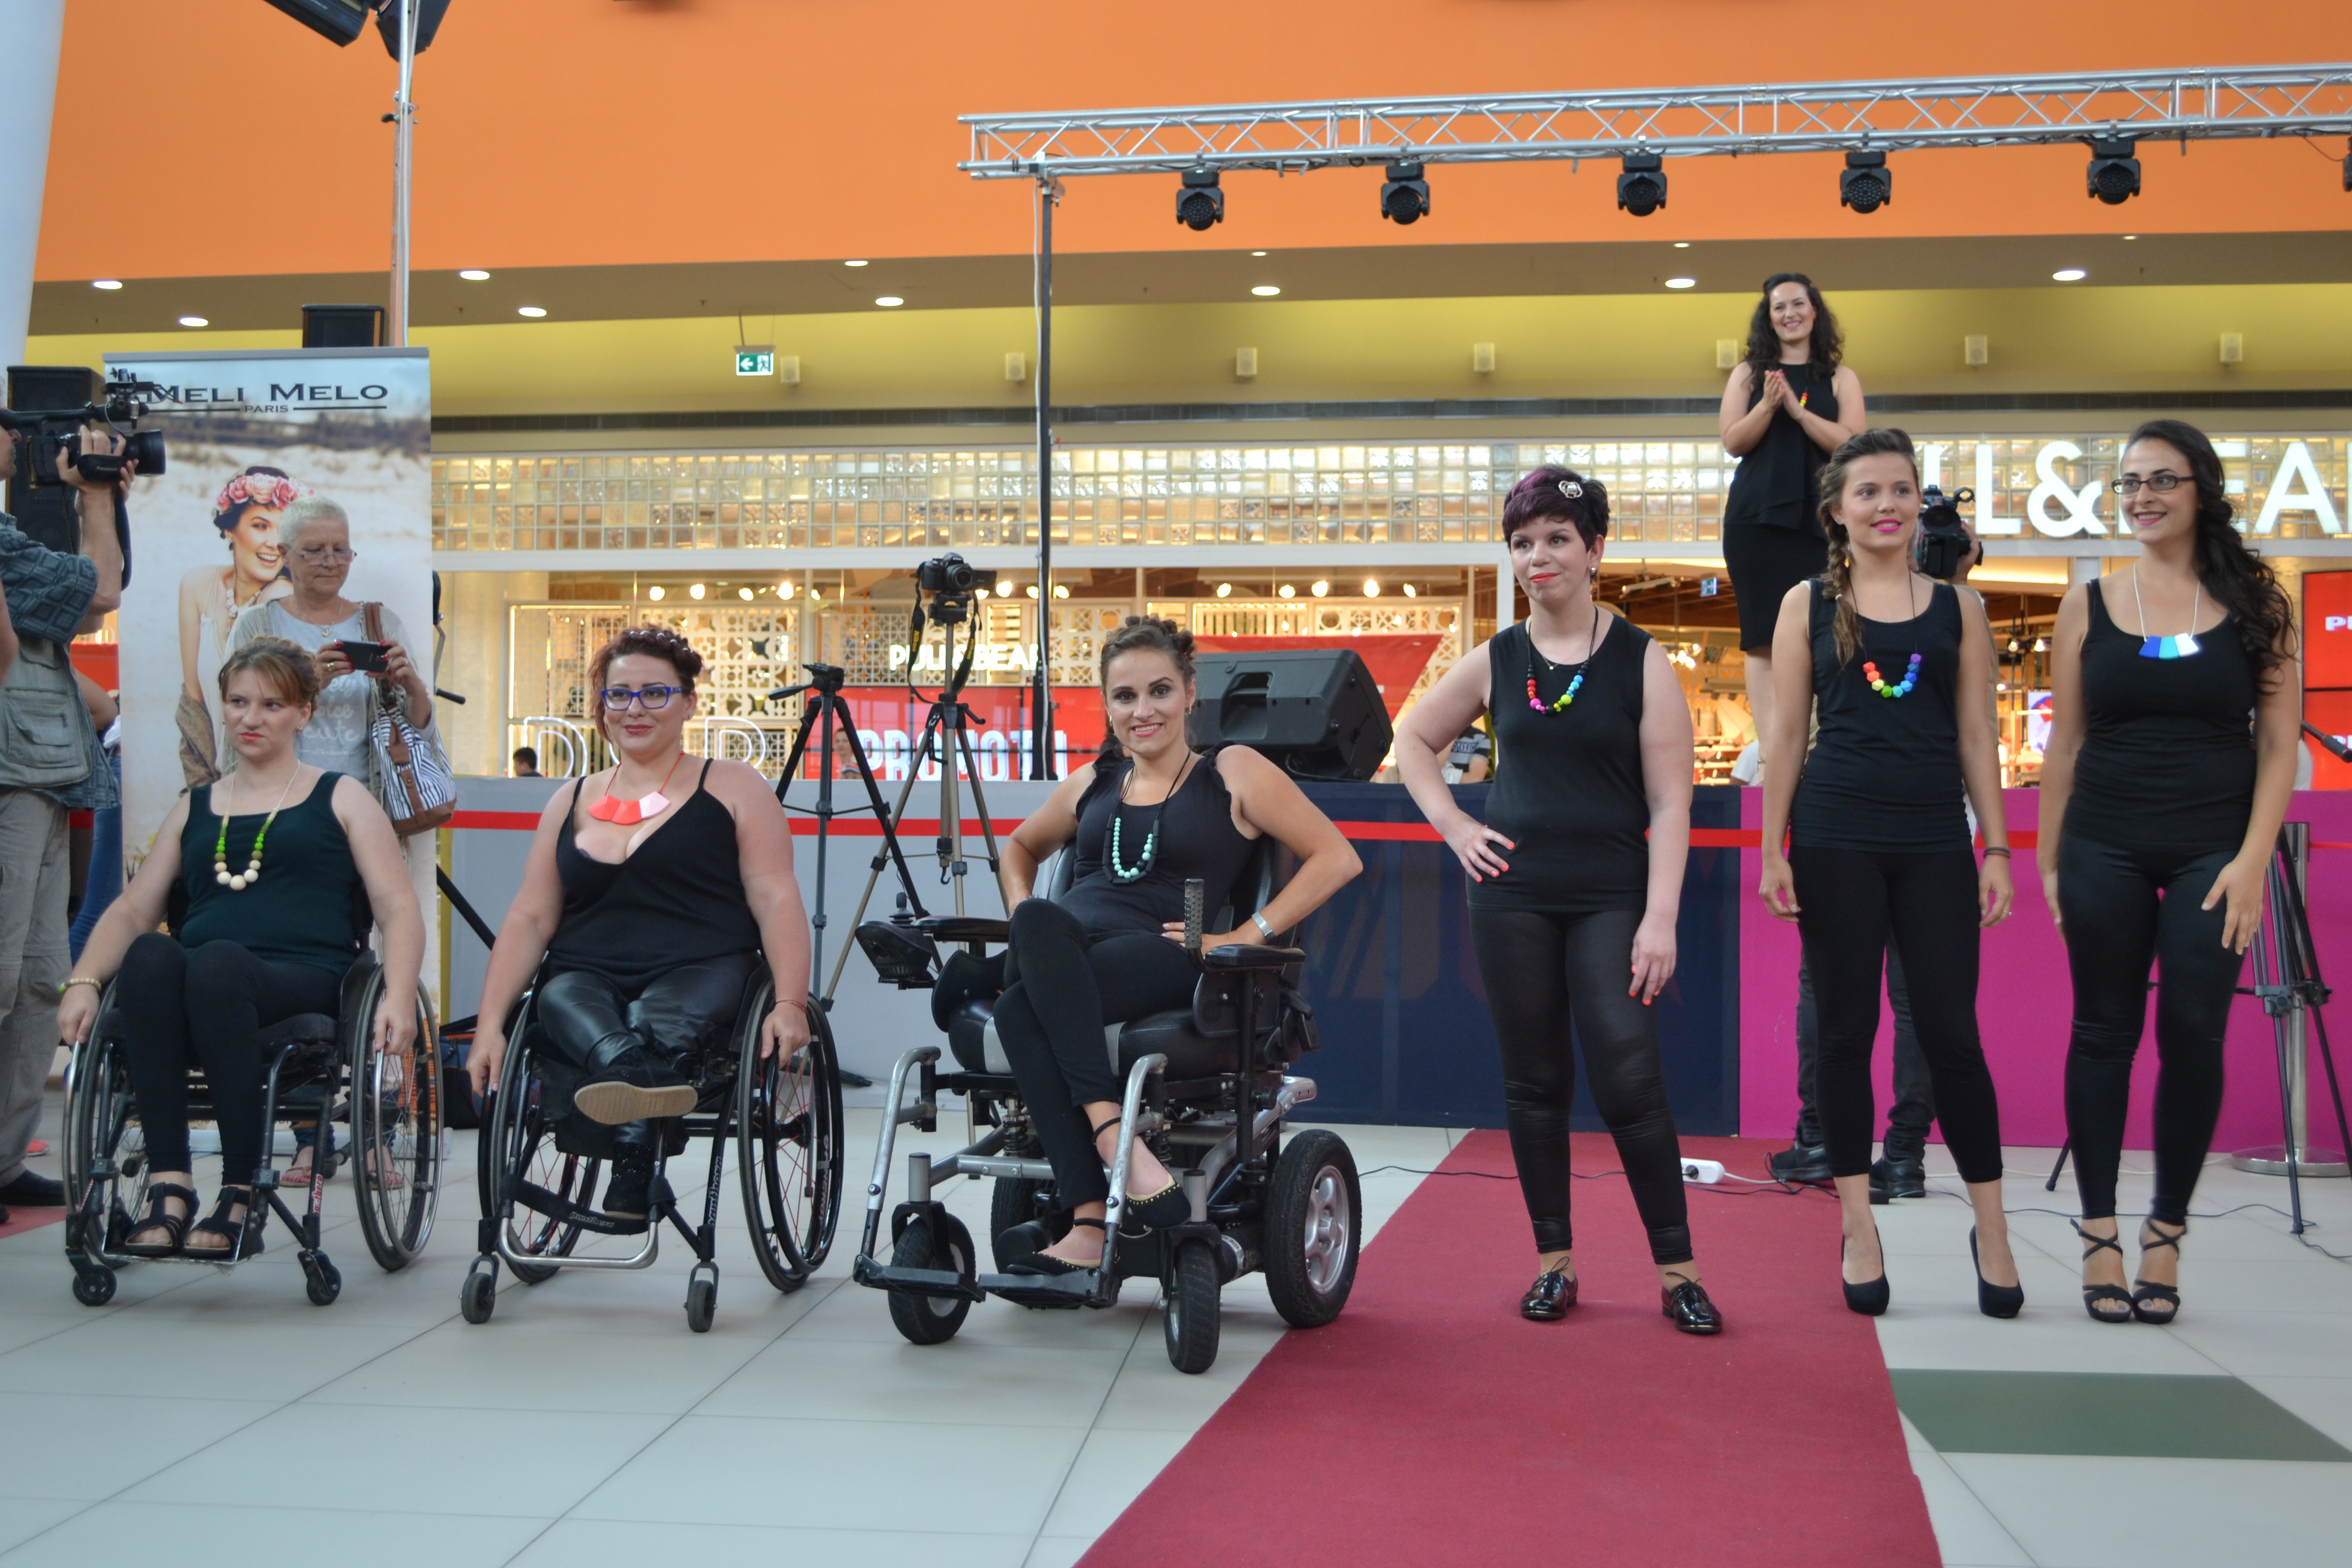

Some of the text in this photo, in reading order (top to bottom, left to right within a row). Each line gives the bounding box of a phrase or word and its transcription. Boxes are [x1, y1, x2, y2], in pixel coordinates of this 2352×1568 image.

[146, 383, 388, 403] MELI MELO
[244, 405, 288, 413] PARIS
[302, 719, 360, 745] cute
[856, 729, 1067, 781] PROMOTI
[313, 1173, 323, 1213] athera
[569, 1211, 615, 1228] panthera
